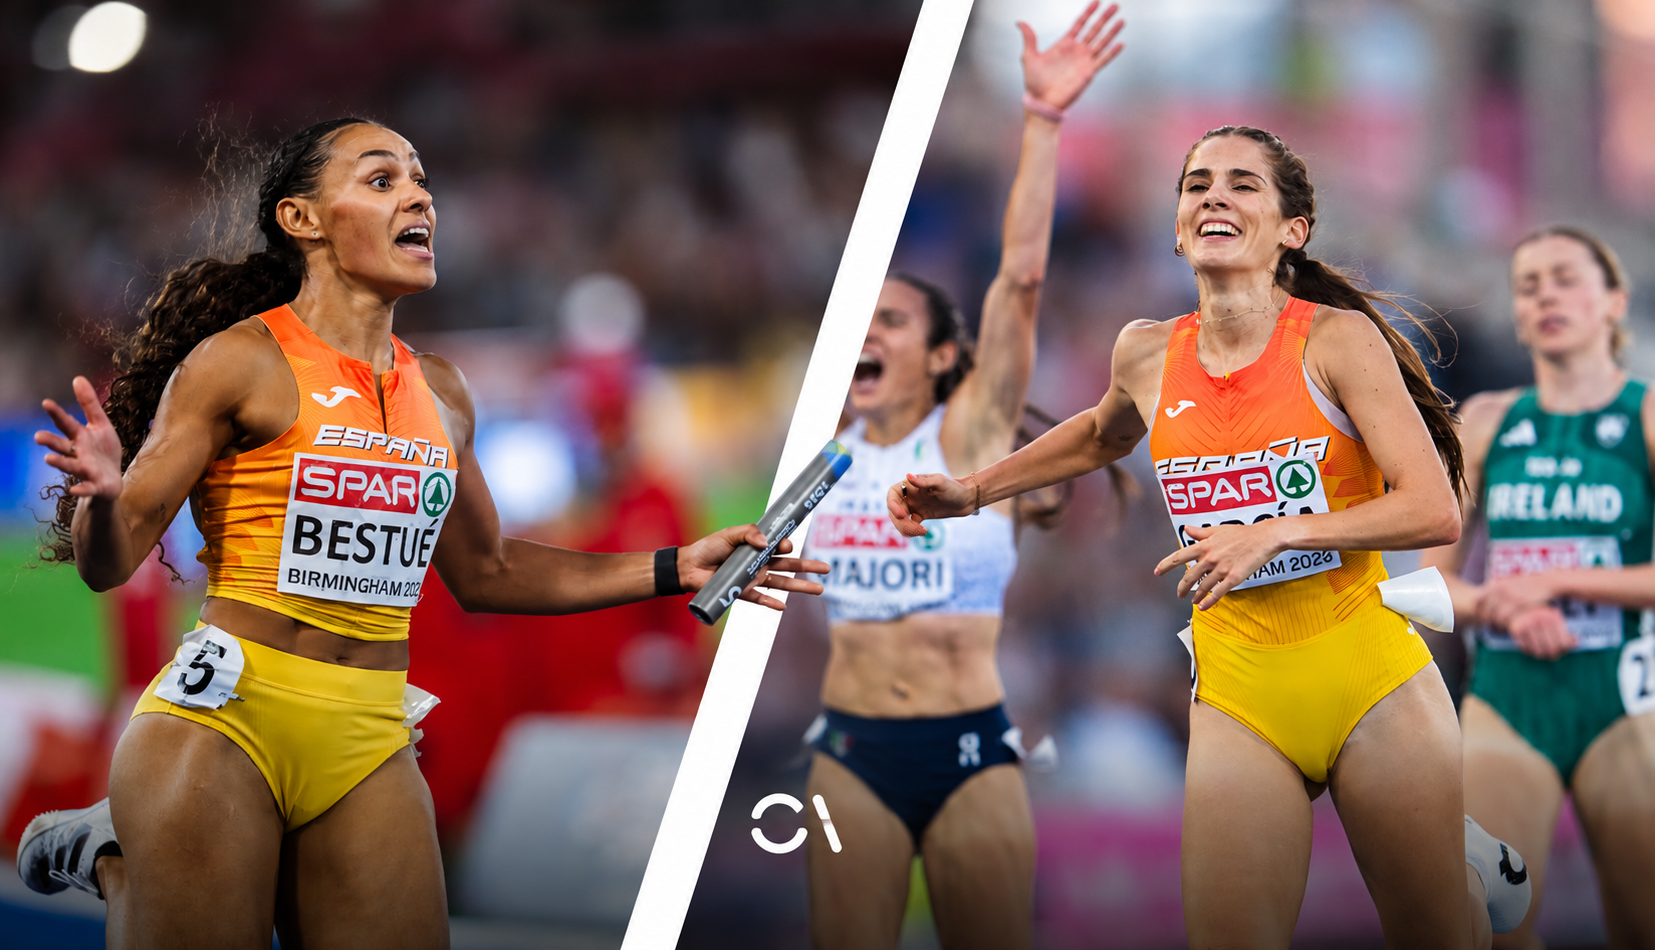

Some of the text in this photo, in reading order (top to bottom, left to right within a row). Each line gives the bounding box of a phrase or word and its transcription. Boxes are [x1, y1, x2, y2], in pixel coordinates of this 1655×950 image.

[313, 424, 448, 468] ESPAÑA
[301, 466, 416, 508] SPAR
[1167, 472, 1272, 509] SPAR
[1486, 482, 1623, 523] IRELAND
[292, 514, 439, 568] BESTUÉ
[287, 568, 421, 597] BIRMINGHAM 202
[177, 640, 227, 695] 5
